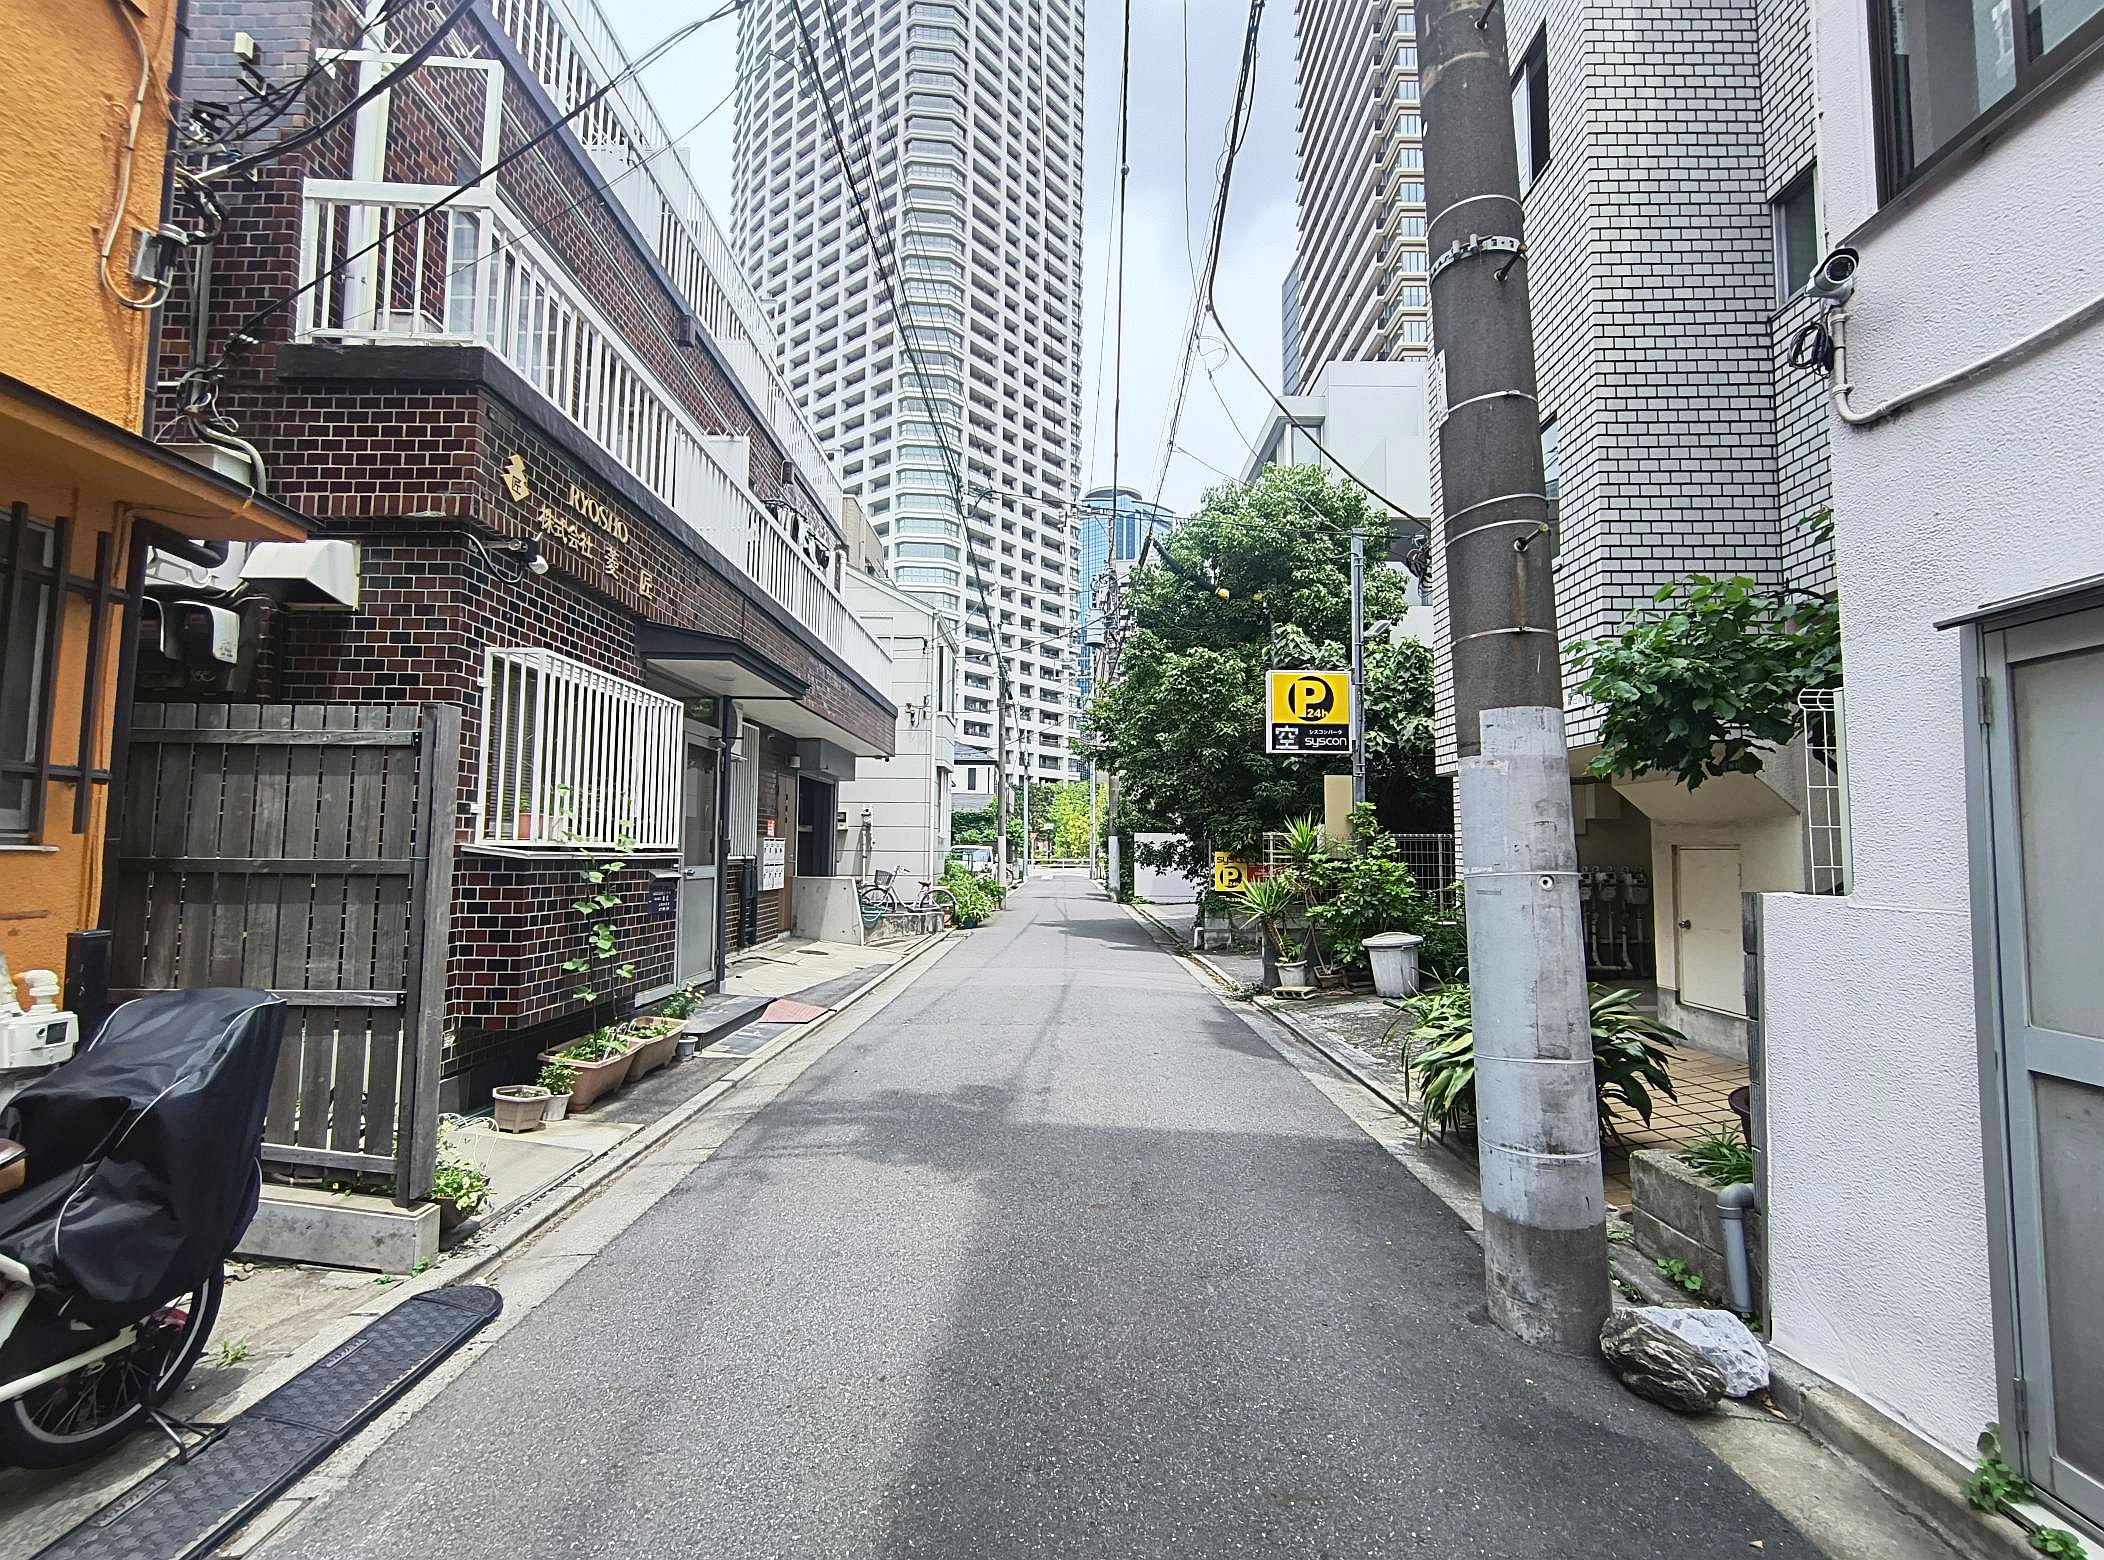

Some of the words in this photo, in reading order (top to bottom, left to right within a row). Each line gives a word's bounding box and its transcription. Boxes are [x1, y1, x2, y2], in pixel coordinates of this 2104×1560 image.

[511, 475, 522, 496] 匠
[569, 484, 629, 544] RYOSHO
[1294, 680, 1326, 717] P
[1306, 708, 1329, 718] 24h
[1304, 737, 1347, 748] syscon
[1223, 867, 1239, 887] P
